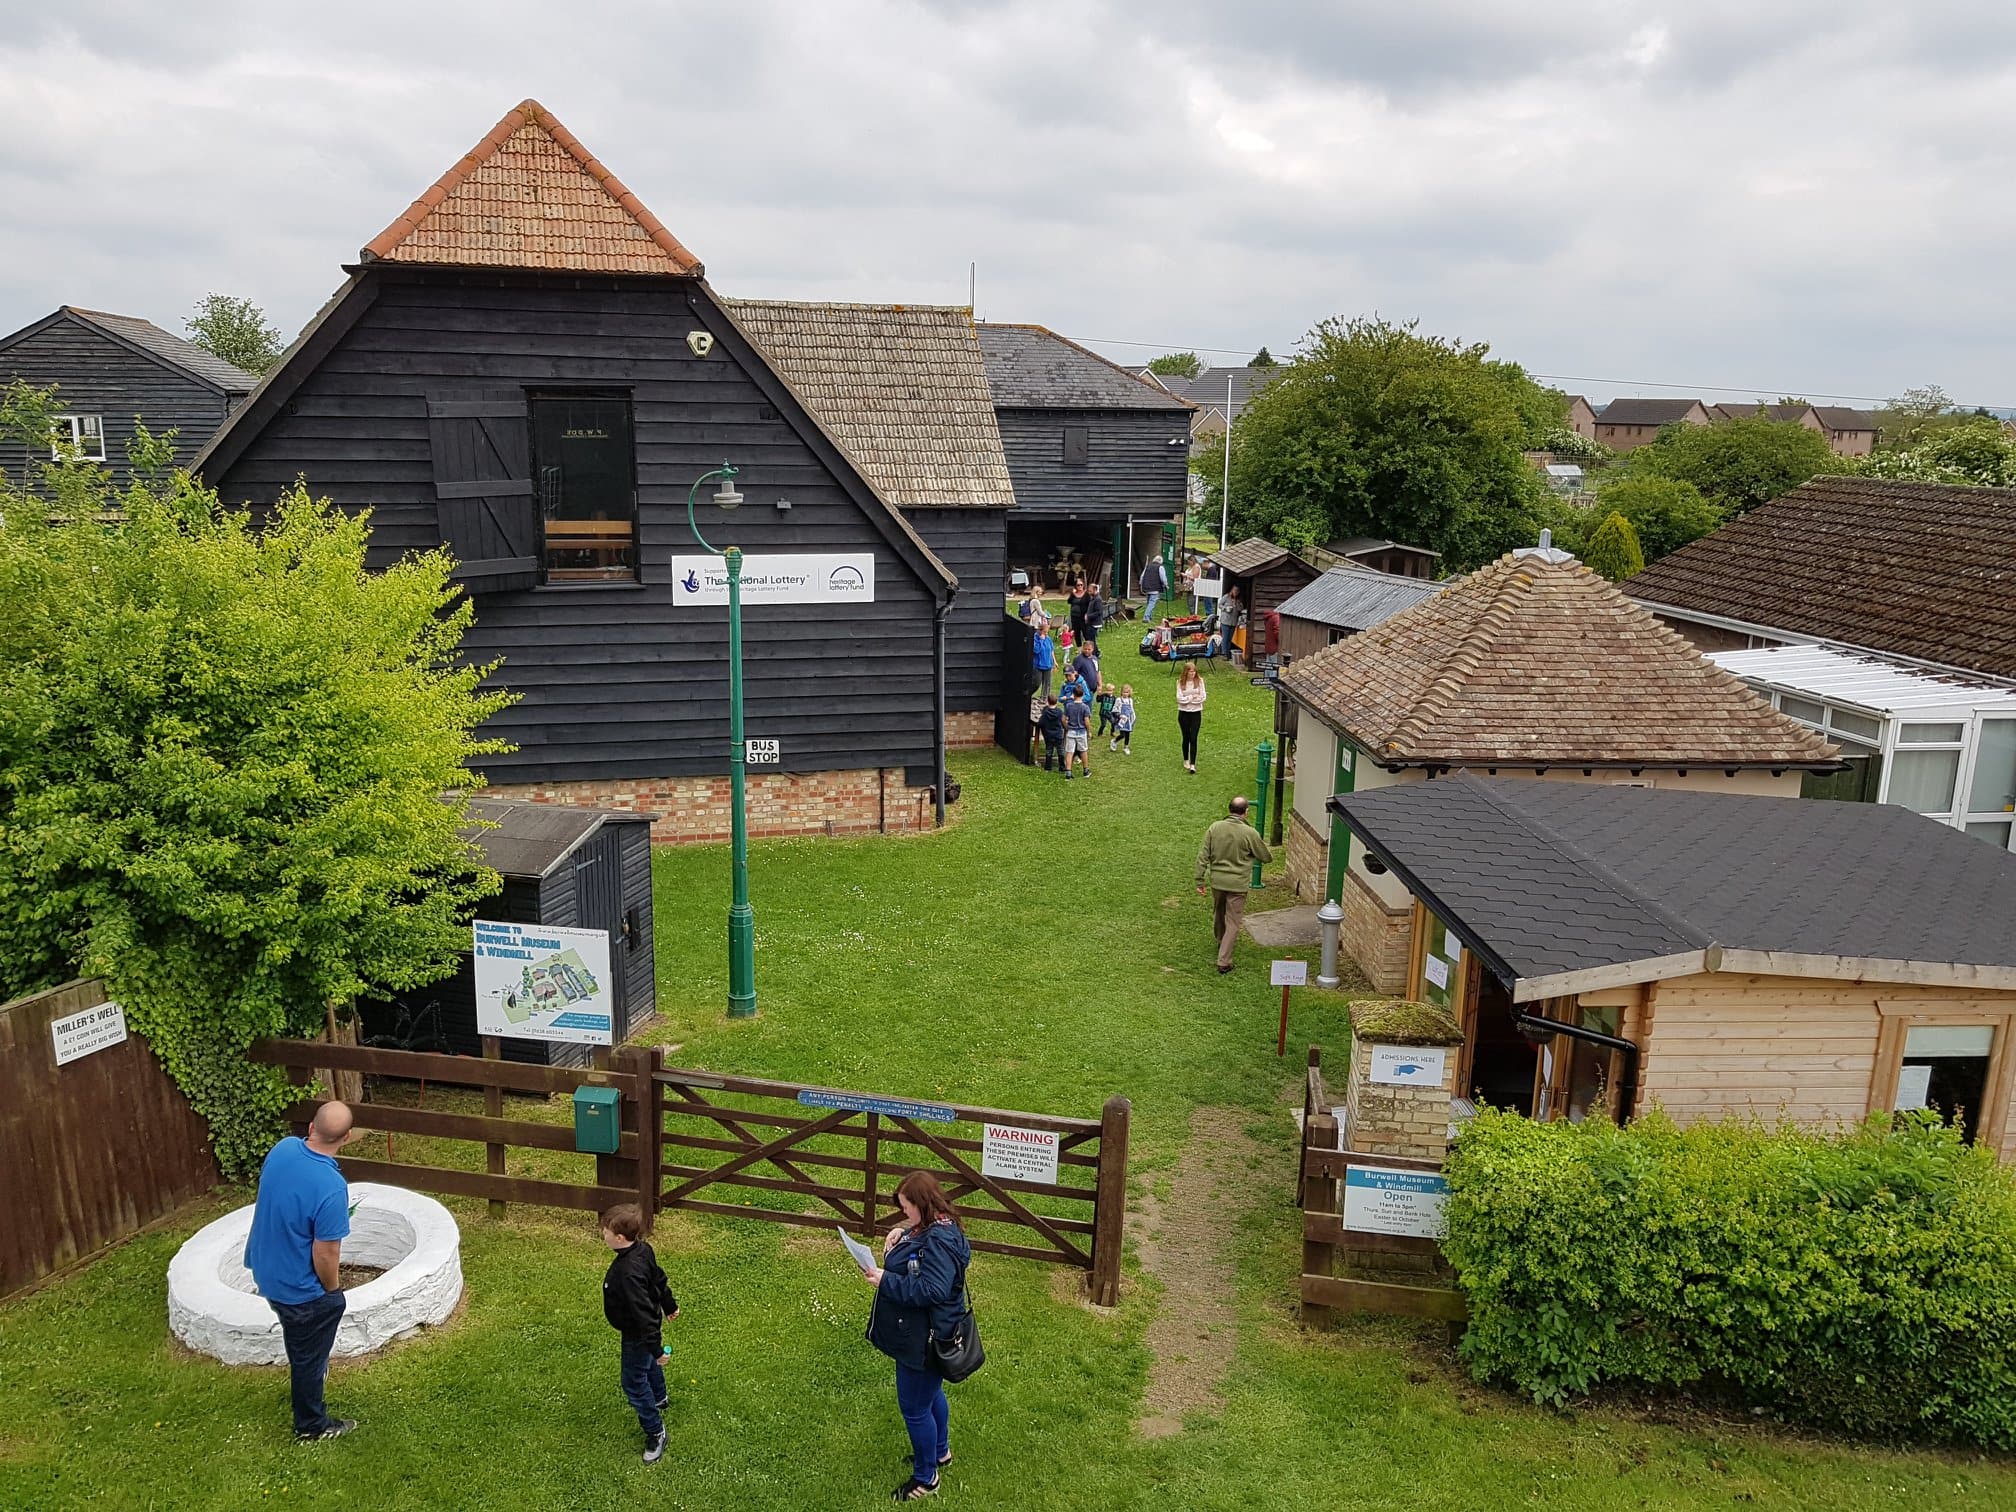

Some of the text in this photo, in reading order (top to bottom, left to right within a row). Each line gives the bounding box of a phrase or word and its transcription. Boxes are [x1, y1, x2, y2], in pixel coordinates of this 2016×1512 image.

[705, 576, 723, 585] The
[771, 576, 805, 585] Lottery
[830, 578, 856, 586] heritage
[752, 741, 774, 750] BUS
[749, 753, 778, 762] STOP
[476, 923, 510, 933] WELCOME
[476, 933, 560, 949] BURWELL MUSEUM
[476, 945, 534, 960] & WINDMILL
[56, 1006, 119, 1036] MILLER'S WELL
[76, 1031, 90, 1041] COIN
[91, 1027, 103, 1038] WILL
[104, 1021, 116, 1030] GIVE
[61, 1050, 72, 1058] YOU
[78, 1039, 97, 1052] REALLY
[98, 1035, 108, 1044] BIG
[1381, 1054, 1418, 1062] ADMISSIONS
[920, 1112, 950, 1120] SHILLINGS
[989, 1127, 1053, 1144] WARNING
[990, 1142, 1051, 1154] PERSONS ENTERING
[988, 1155, 1017, 1163] ACTIVATE
[1007, 1151, 1038, 1159] PREMISES
[1019, 1165, 1044, 1173] SYSTEM
[1364, 1172, 1434, 1184] Burwell Museum
[1385, 1182, 1422, 1192] Windmill
[1384, 1191, 1412, 1202] Open
